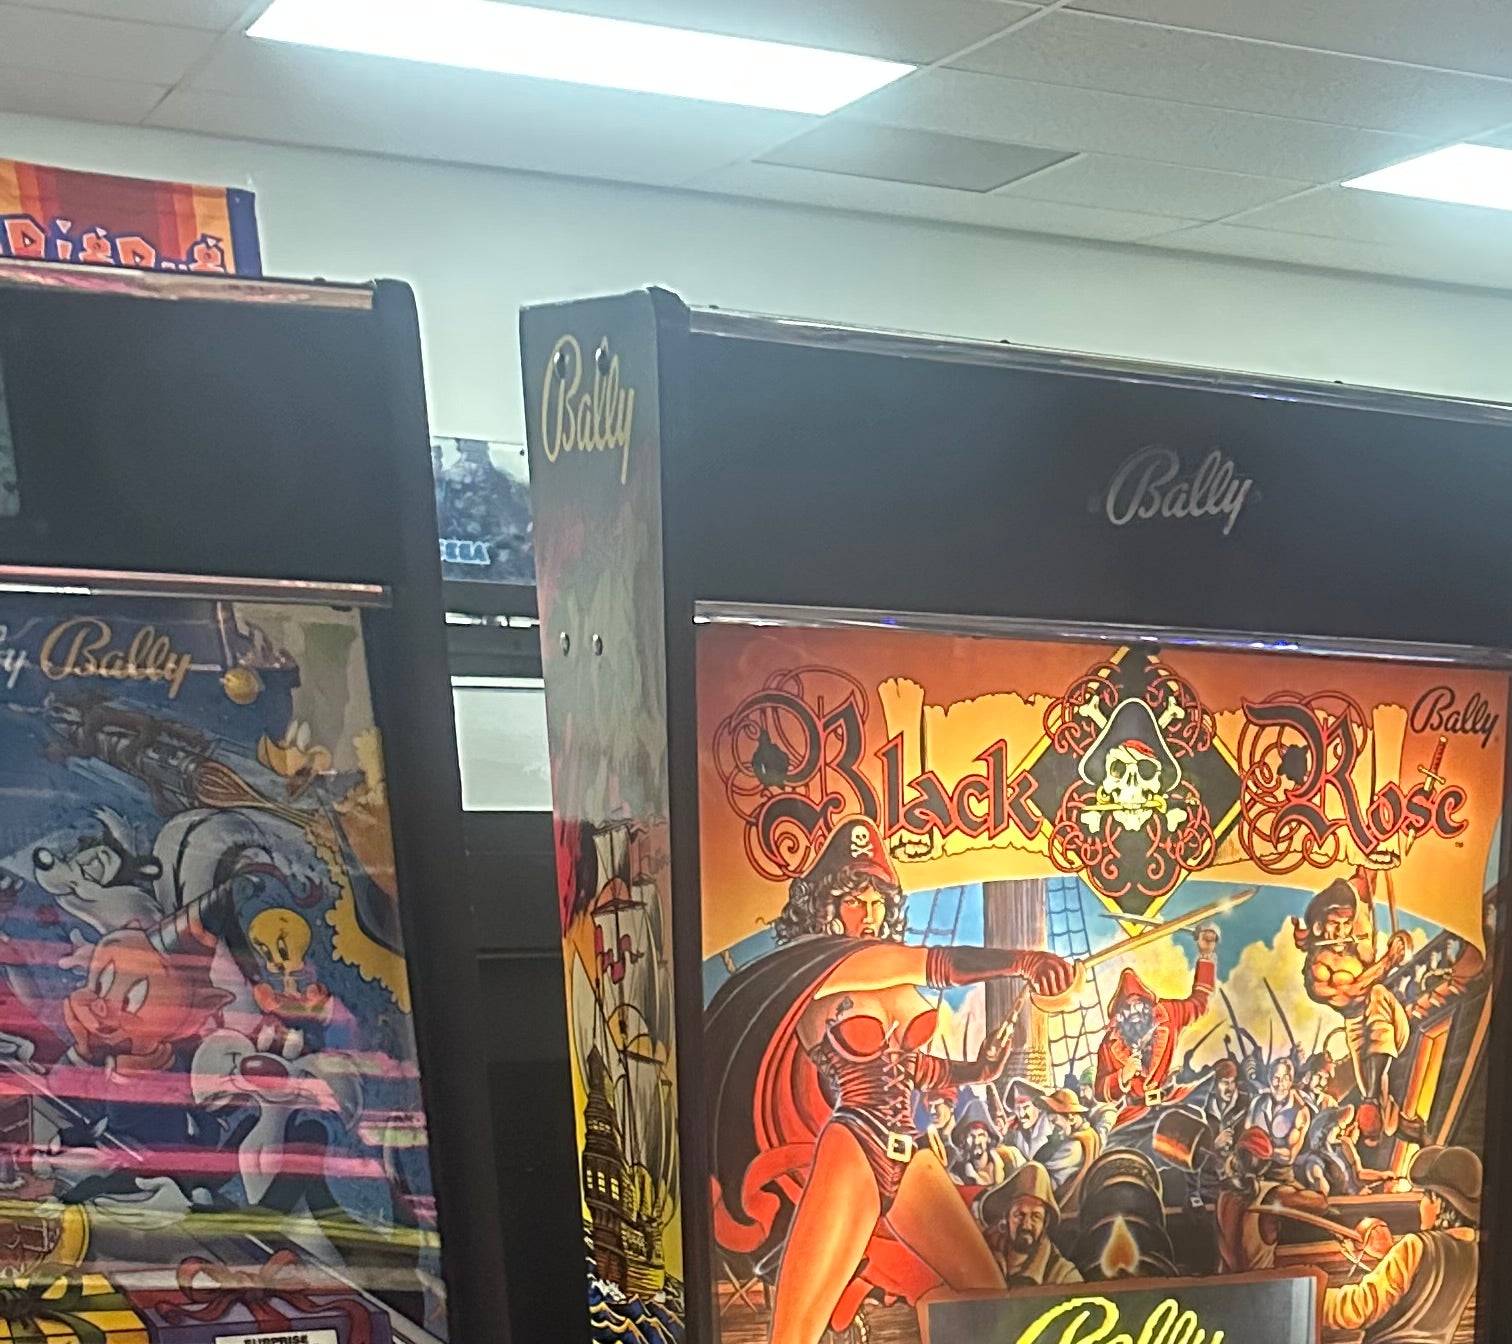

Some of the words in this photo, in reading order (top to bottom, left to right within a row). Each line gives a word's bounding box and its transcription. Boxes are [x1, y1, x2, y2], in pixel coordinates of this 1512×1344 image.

[540, 334, 636, 485] Bally
[1104, 447, 1255, 536] Bally
[40, 614, 192, 699] Bally
[1411, 684, 1502, 747] Bally
[715, 670, 1045, 880] Black
[1240, 690, 1469, 873] Rose
